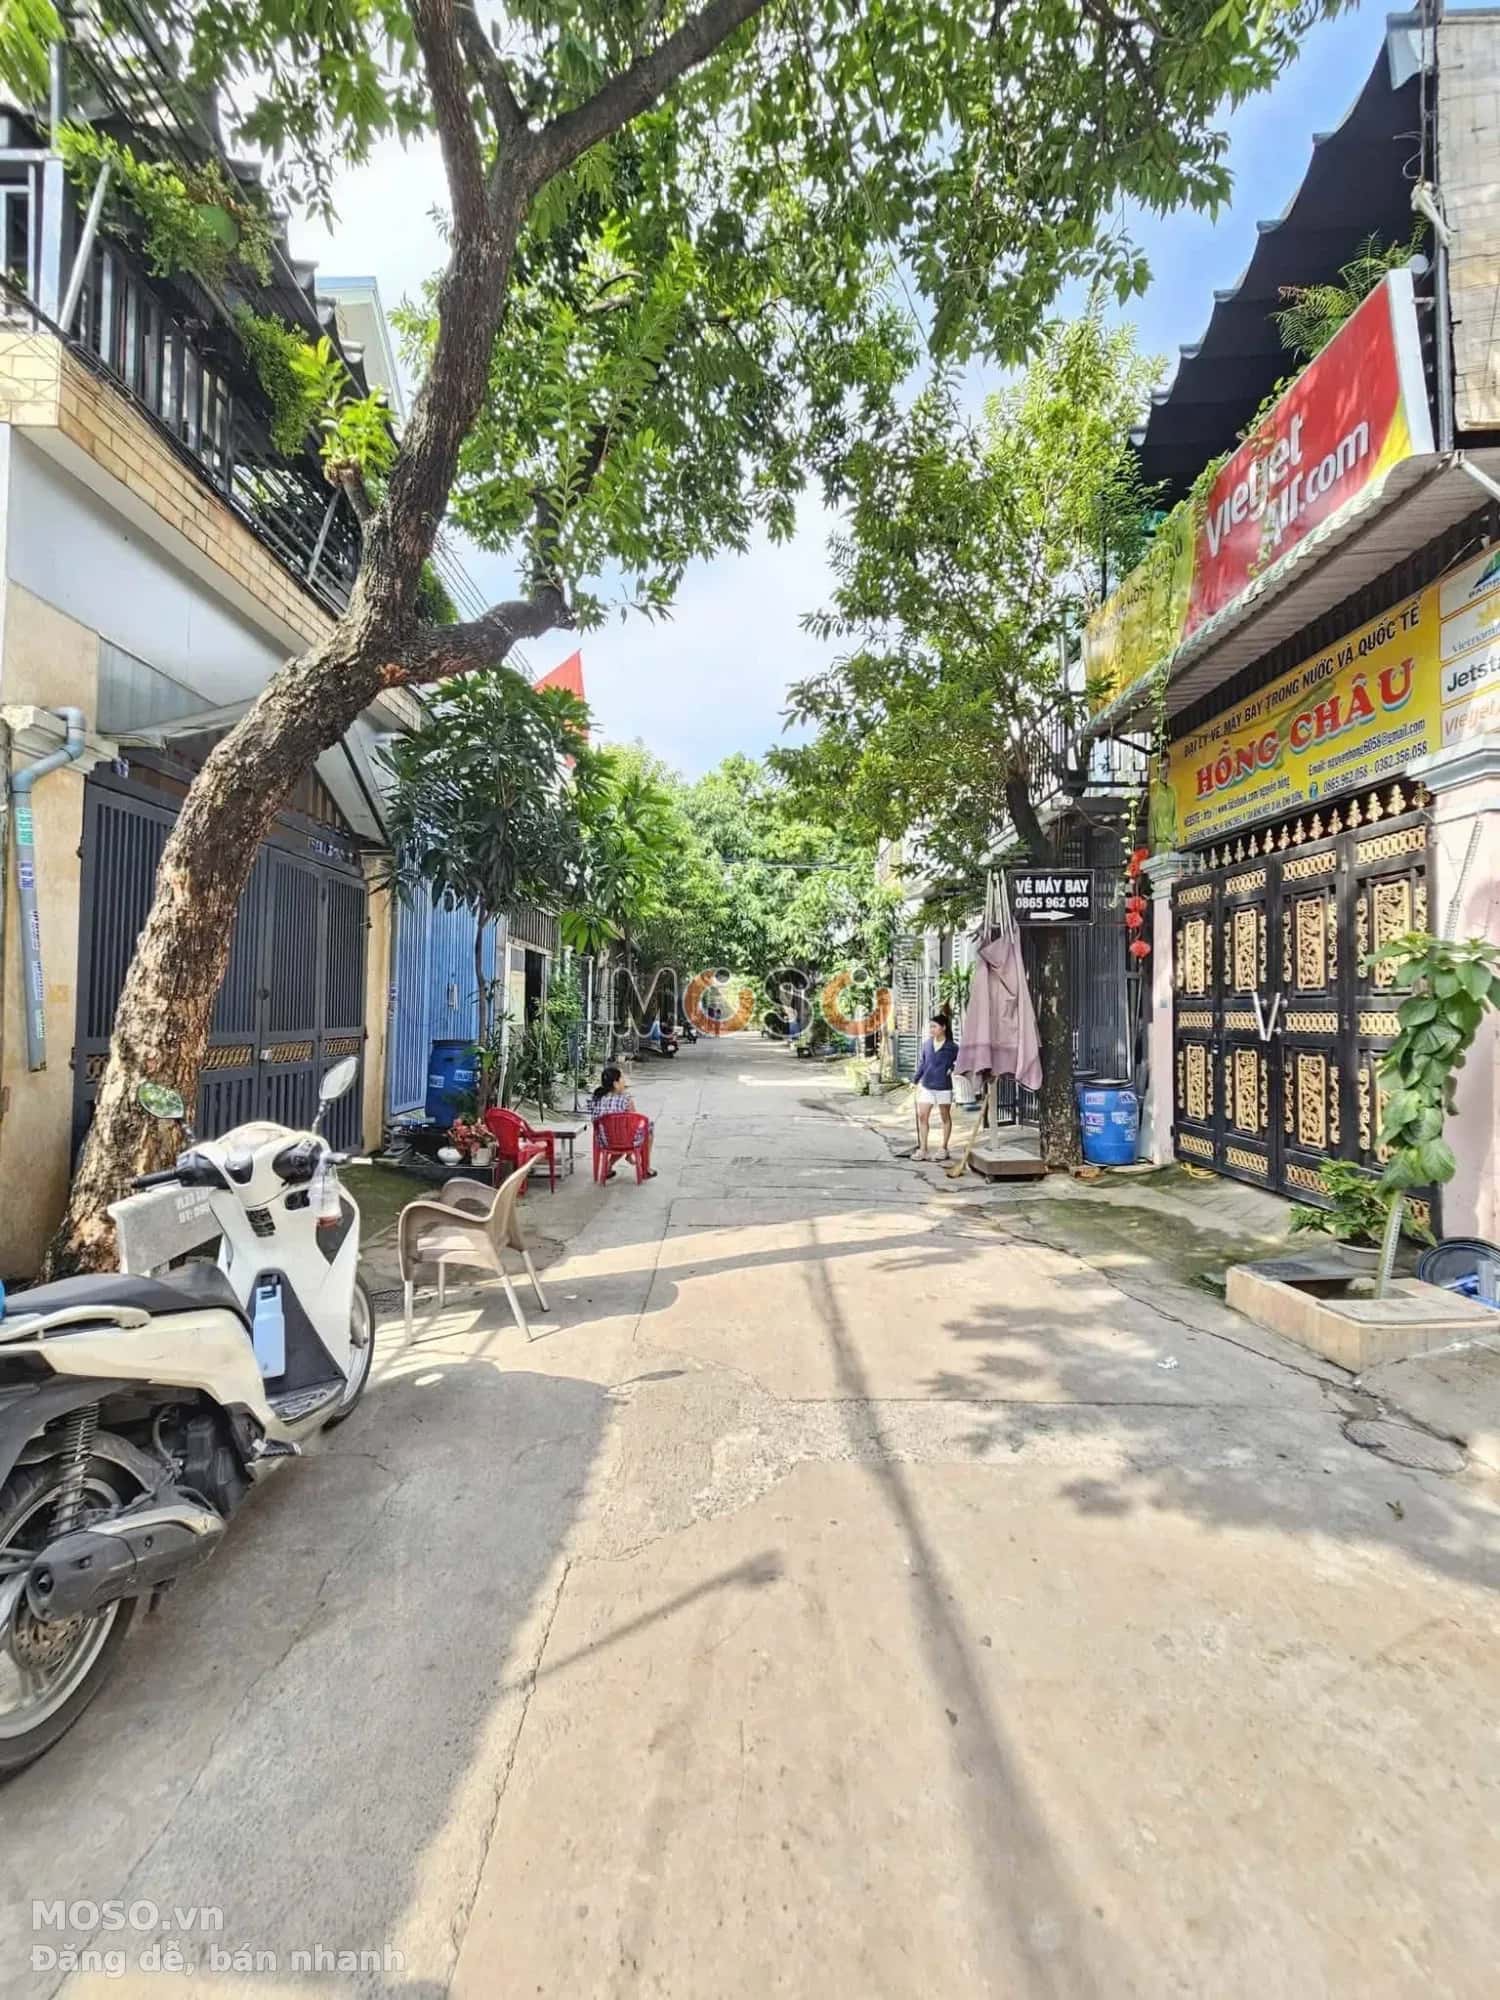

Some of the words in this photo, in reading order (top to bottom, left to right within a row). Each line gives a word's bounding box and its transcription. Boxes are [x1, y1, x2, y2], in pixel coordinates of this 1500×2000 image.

[1244, 702, 1263, 721] BAY
[1266, 680, 1298, 708] TRONG
[1302, 658, 1333, 686] NƯỚC
[1337, 642, 1353, 666] VÀ
[1358, 617, 1395, 656] QUỐC
[1400, 598, 1419, 631] TẾ
[1195, 730, 1280, 799] HỒNG
[1289, 658, 1414, 755] CHÂU
[1015, 897, 1043, 909] 0865
[1045, 897, 1066, 909] 962
[1068, 897, 1089, 909] 058
[1035, 876, 1062, 894] MÁY
[1064, 878, 1089, 894] BAY
